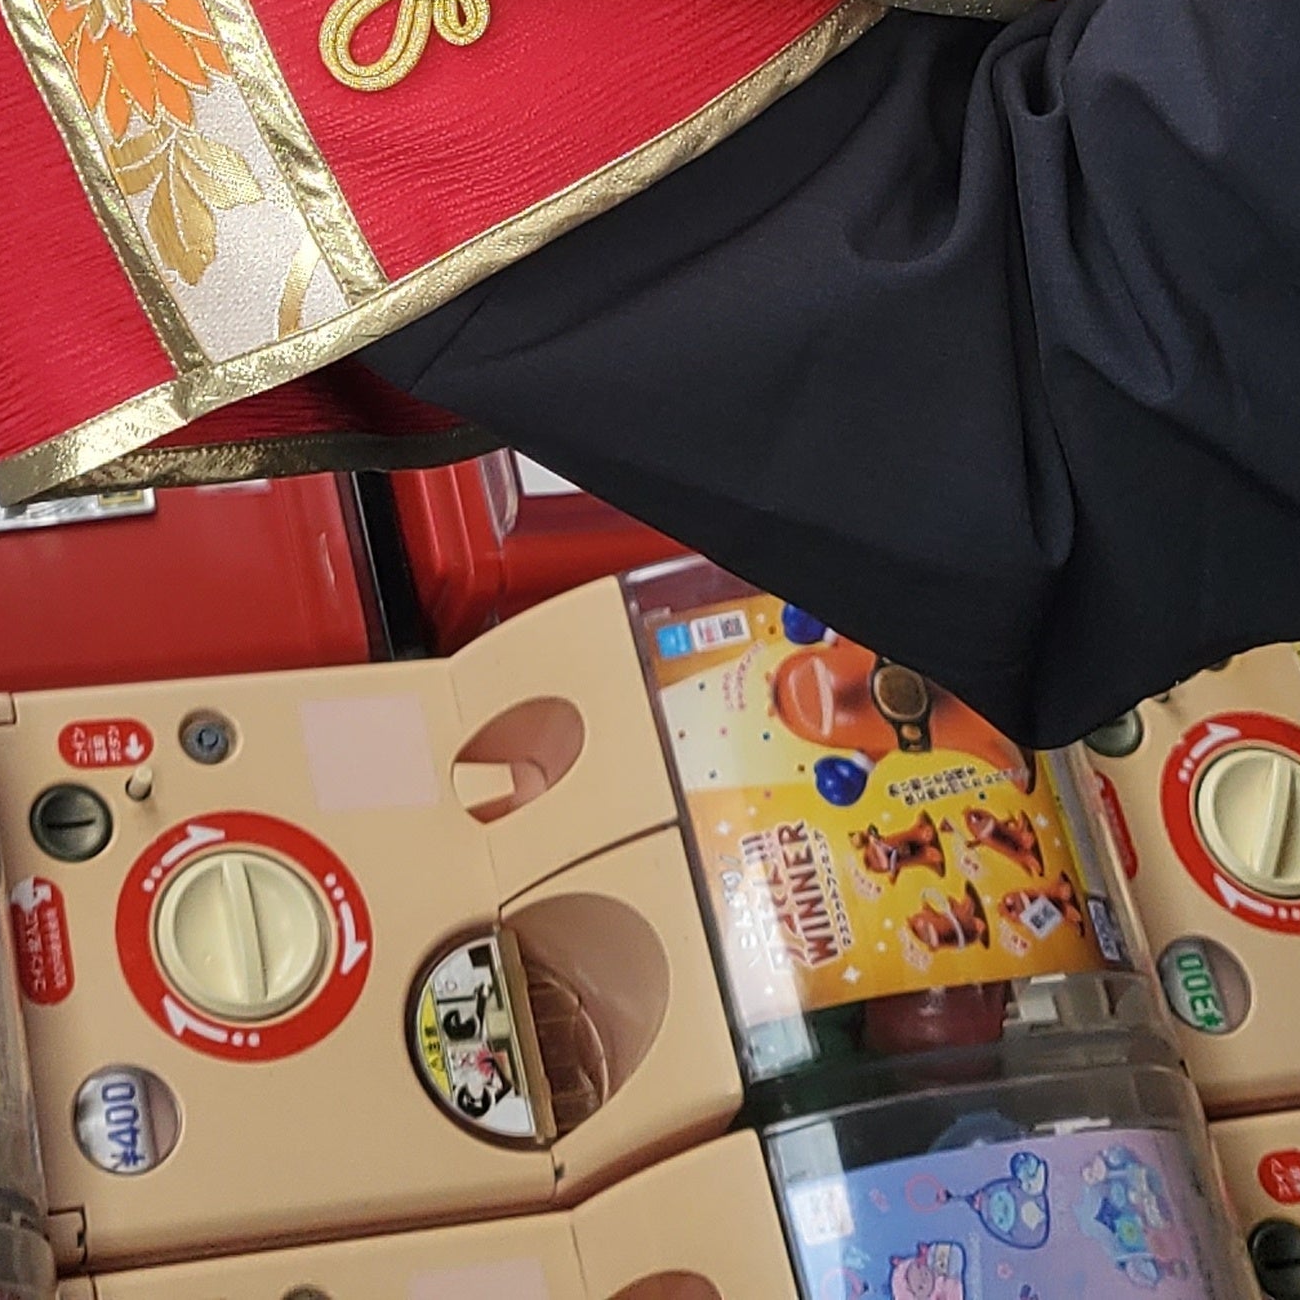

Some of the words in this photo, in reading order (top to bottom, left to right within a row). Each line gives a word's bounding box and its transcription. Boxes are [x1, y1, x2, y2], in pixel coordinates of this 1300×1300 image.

[779, 821, 840, 967] WINNER
[1175, 952, 1225, 1029] ¥300
[100, 1081, 146, 1168] ¥400
